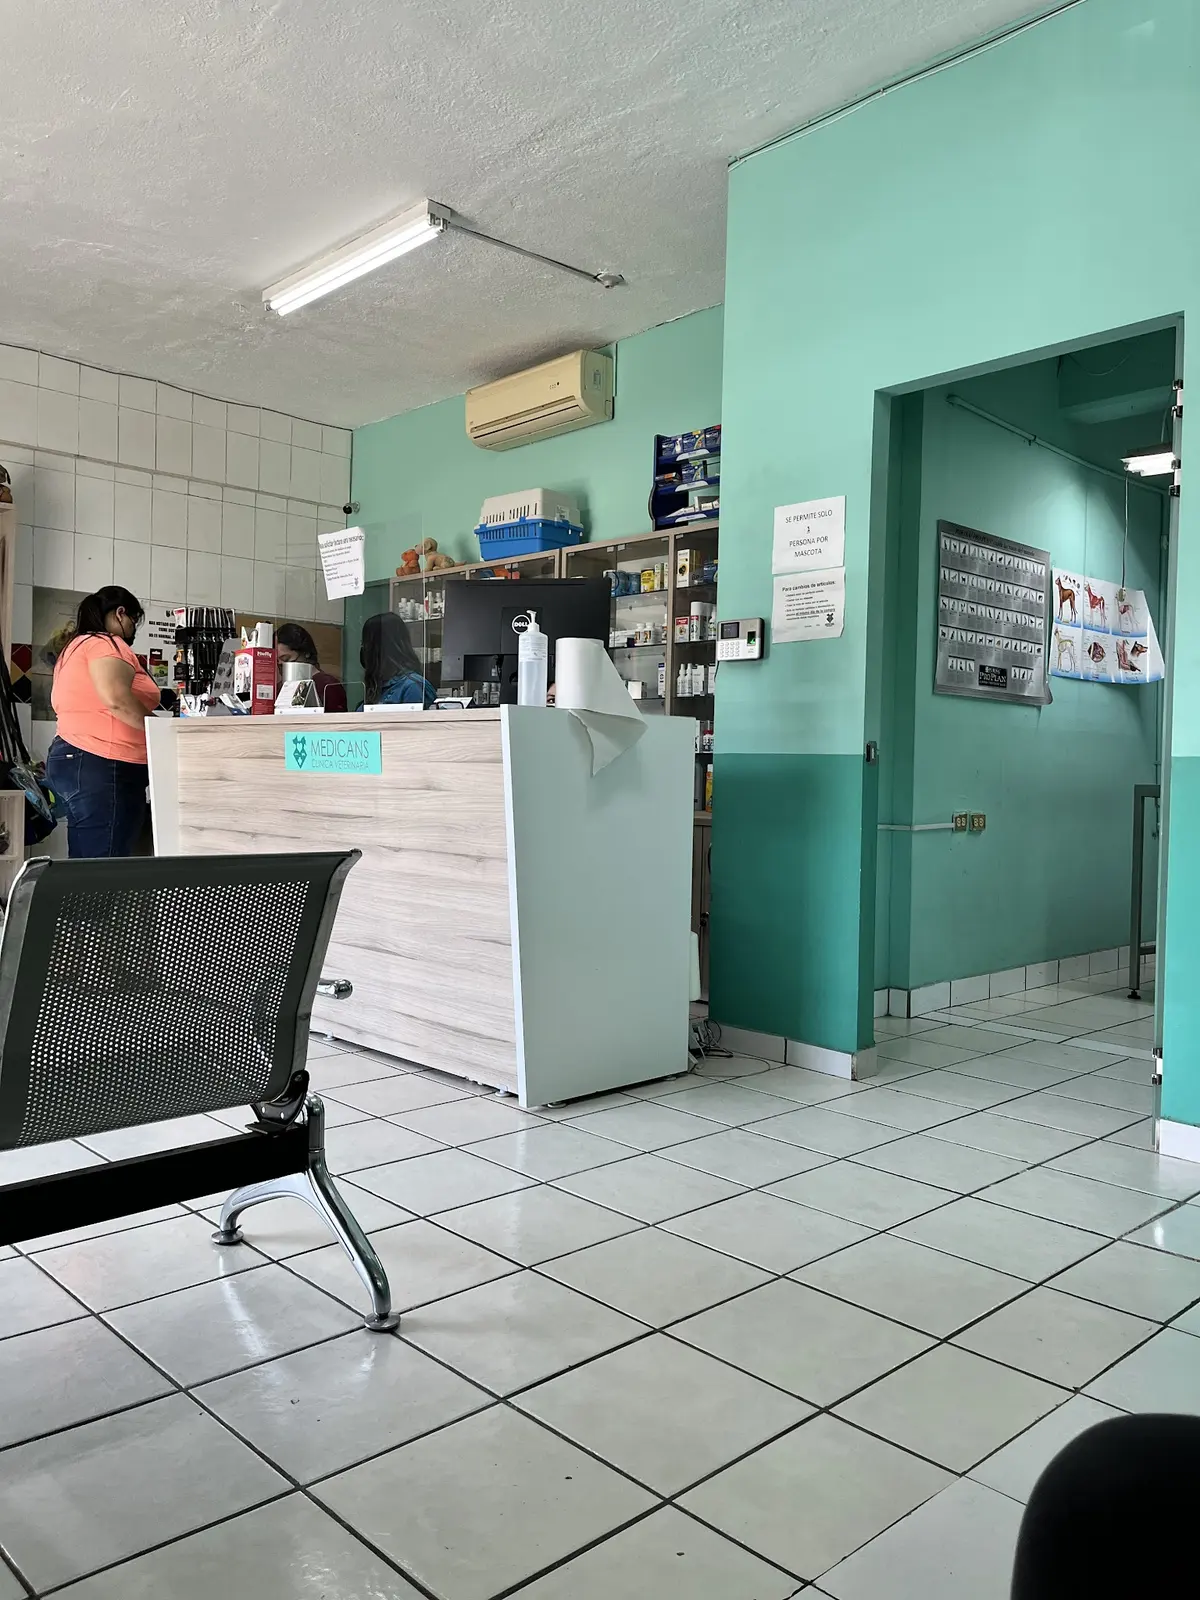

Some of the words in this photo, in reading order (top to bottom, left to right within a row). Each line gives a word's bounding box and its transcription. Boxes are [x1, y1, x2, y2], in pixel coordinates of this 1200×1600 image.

[793, 512, 816, 522] PERMITE
[789, 538, 815, 547] PERSONA
[794, 548, 822, 557] MASCOTA
[311, 739, 369, 758] MEDICANS
[334, 760, 369, 769] VETERINARIA
